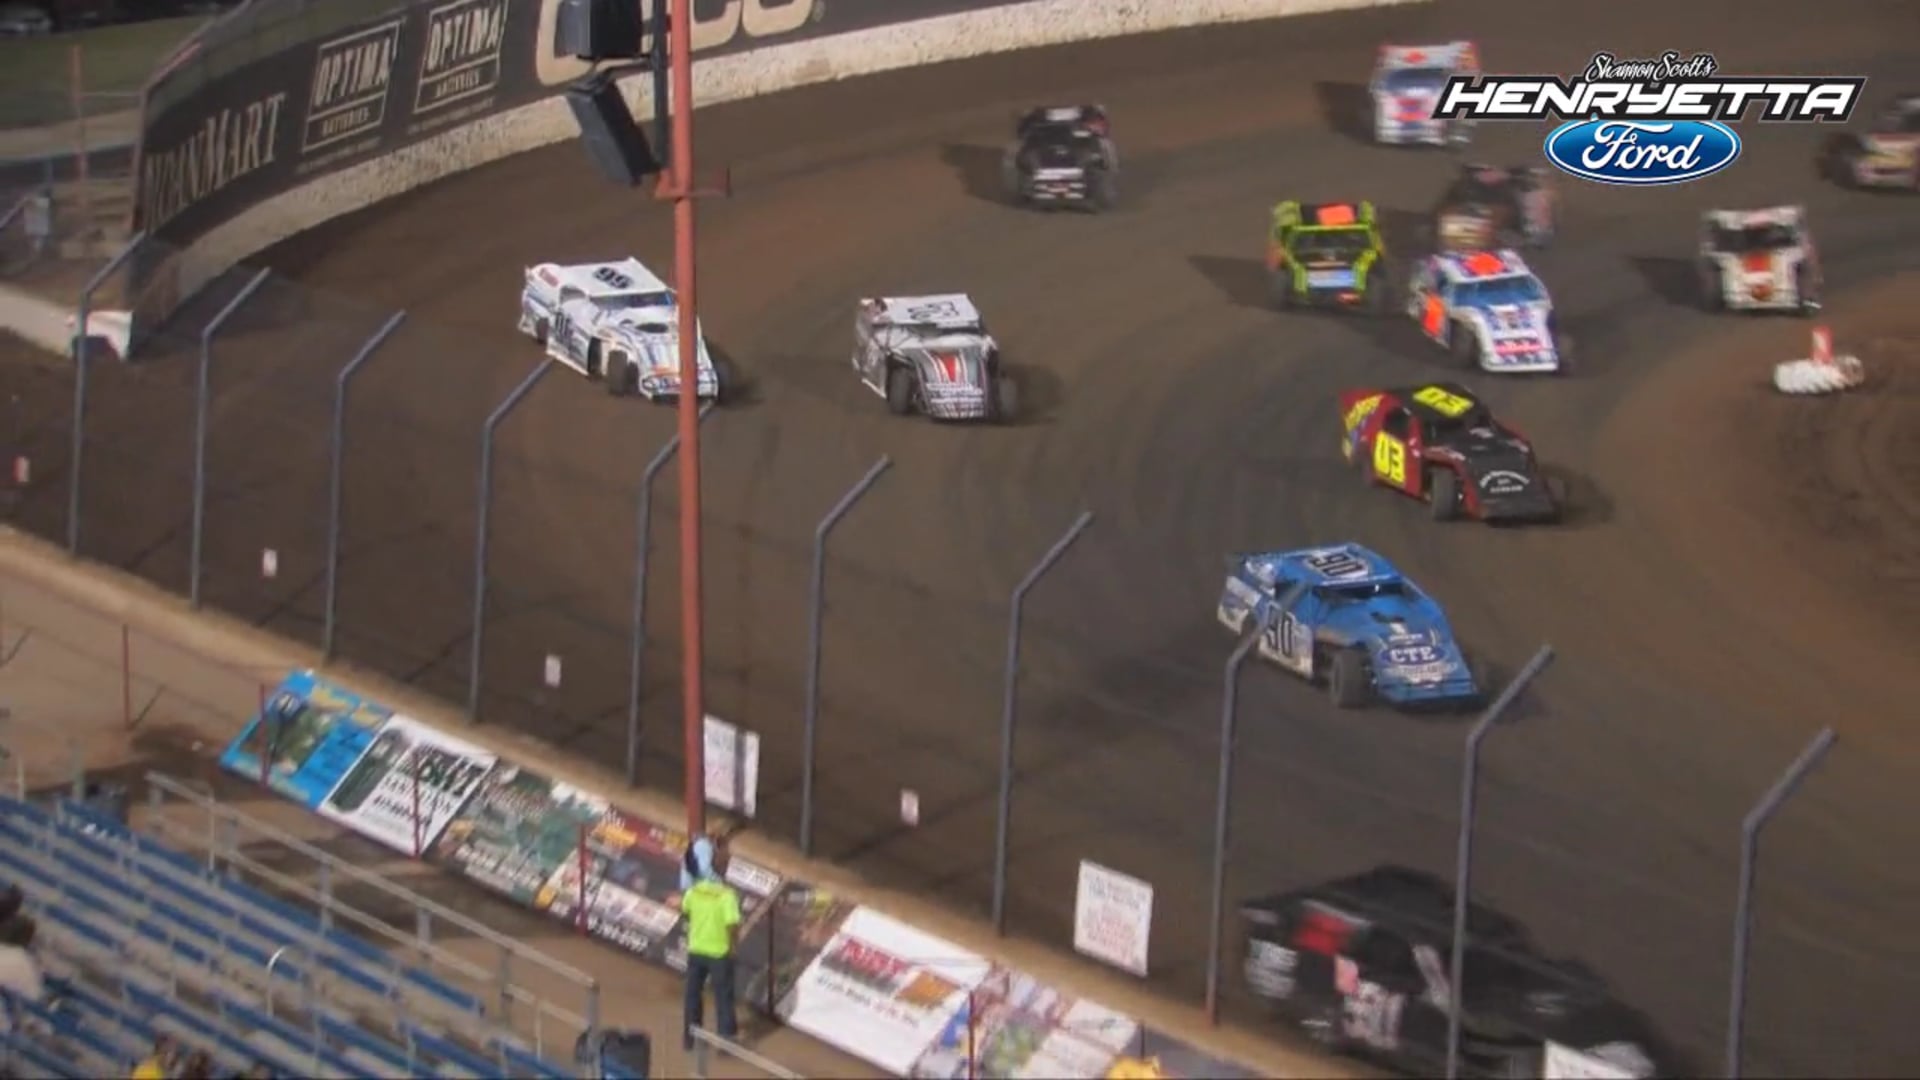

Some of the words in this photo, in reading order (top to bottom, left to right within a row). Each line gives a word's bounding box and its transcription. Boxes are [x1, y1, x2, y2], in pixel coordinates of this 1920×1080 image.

[314, 36, 392, 107] OPTIMA
[1412, 386, 1475, 417] 03
[1374, 430, 1406, 483] 03
